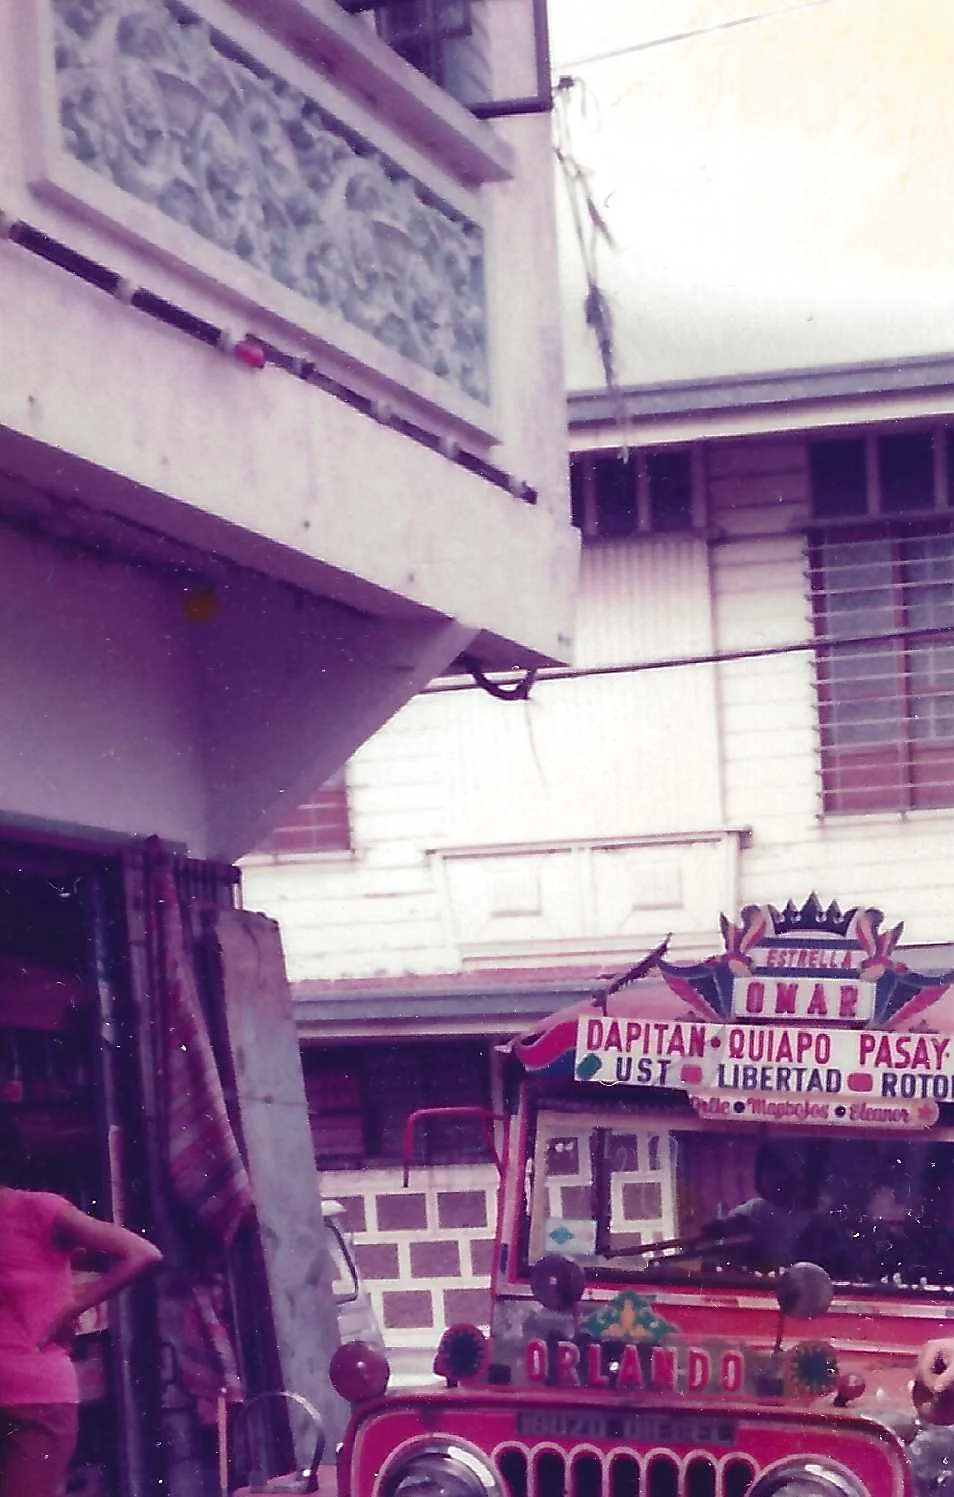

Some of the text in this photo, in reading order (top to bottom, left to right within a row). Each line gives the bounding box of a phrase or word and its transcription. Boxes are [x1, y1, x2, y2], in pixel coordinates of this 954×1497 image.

[766, 949, 854, 968] ESTRELLA
[746, 981, 859, 1017] OMAR
[586, 1018, 706, 1057] DAPITAN
[728, 1029, 832, 1065] QUIAPO
[859, 1033, 946, 1071] PASAY
[615, 1056, 672, 1085] UST
[717, 1063, 841, 1094] LIBERTAD
[525, 1338, 745, 1392] ORLANDO
